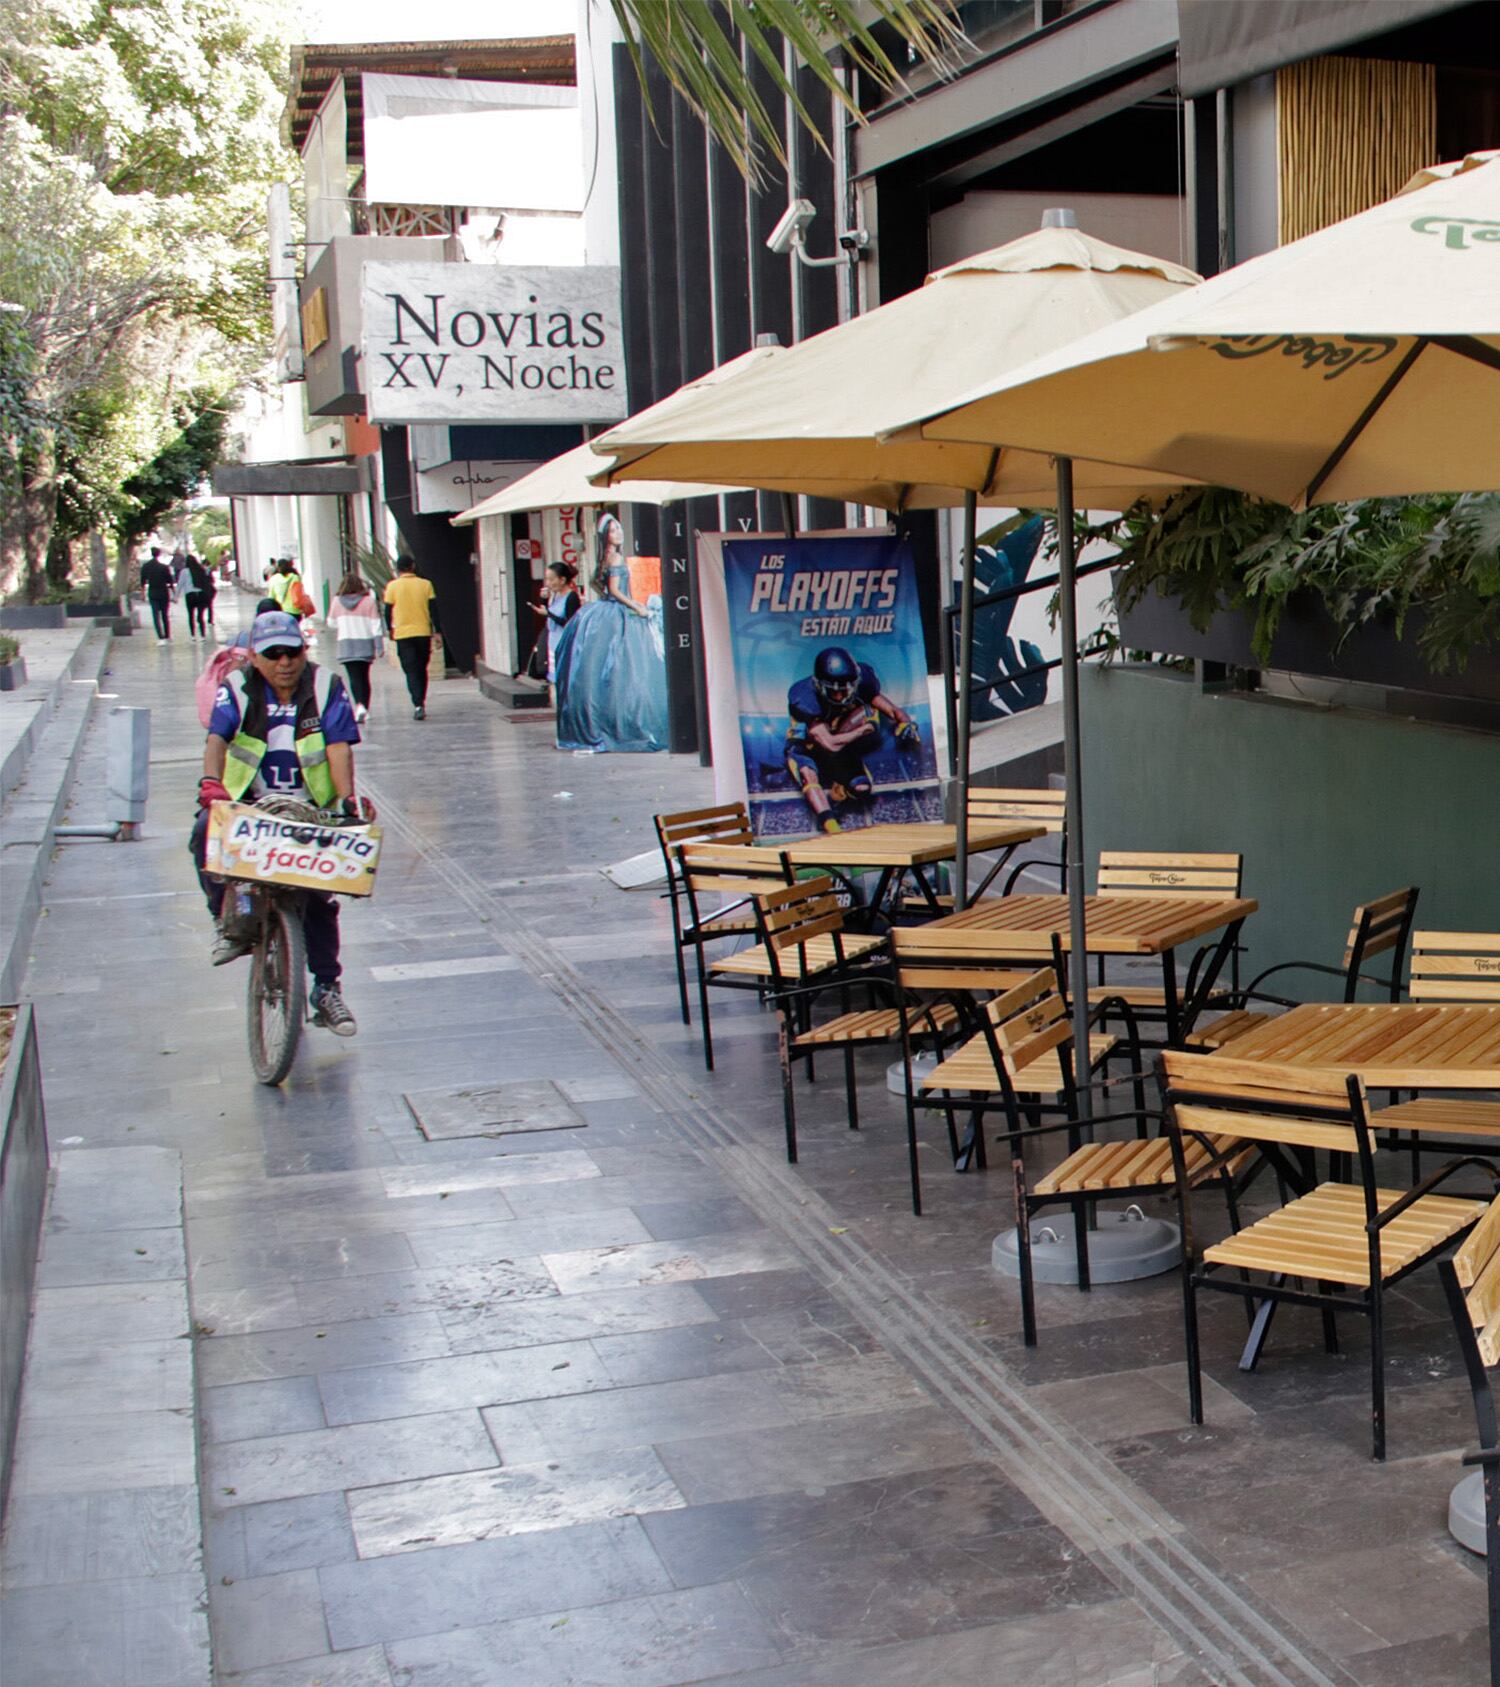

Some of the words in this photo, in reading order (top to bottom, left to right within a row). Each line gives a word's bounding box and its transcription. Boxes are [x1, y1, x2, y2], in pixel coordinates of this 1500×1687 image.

[385, 293, 606, 348] Novias
[479, 354, 615, 391] Noche
[760, 554, 786, 570] LOS
[750, 568, 899, 613] PLAYOFFS
[800, 613, 851, 637] ESTÁN
[852, 610, 895, 634] AQUÍ
[263, 847, 336, 875] facio
